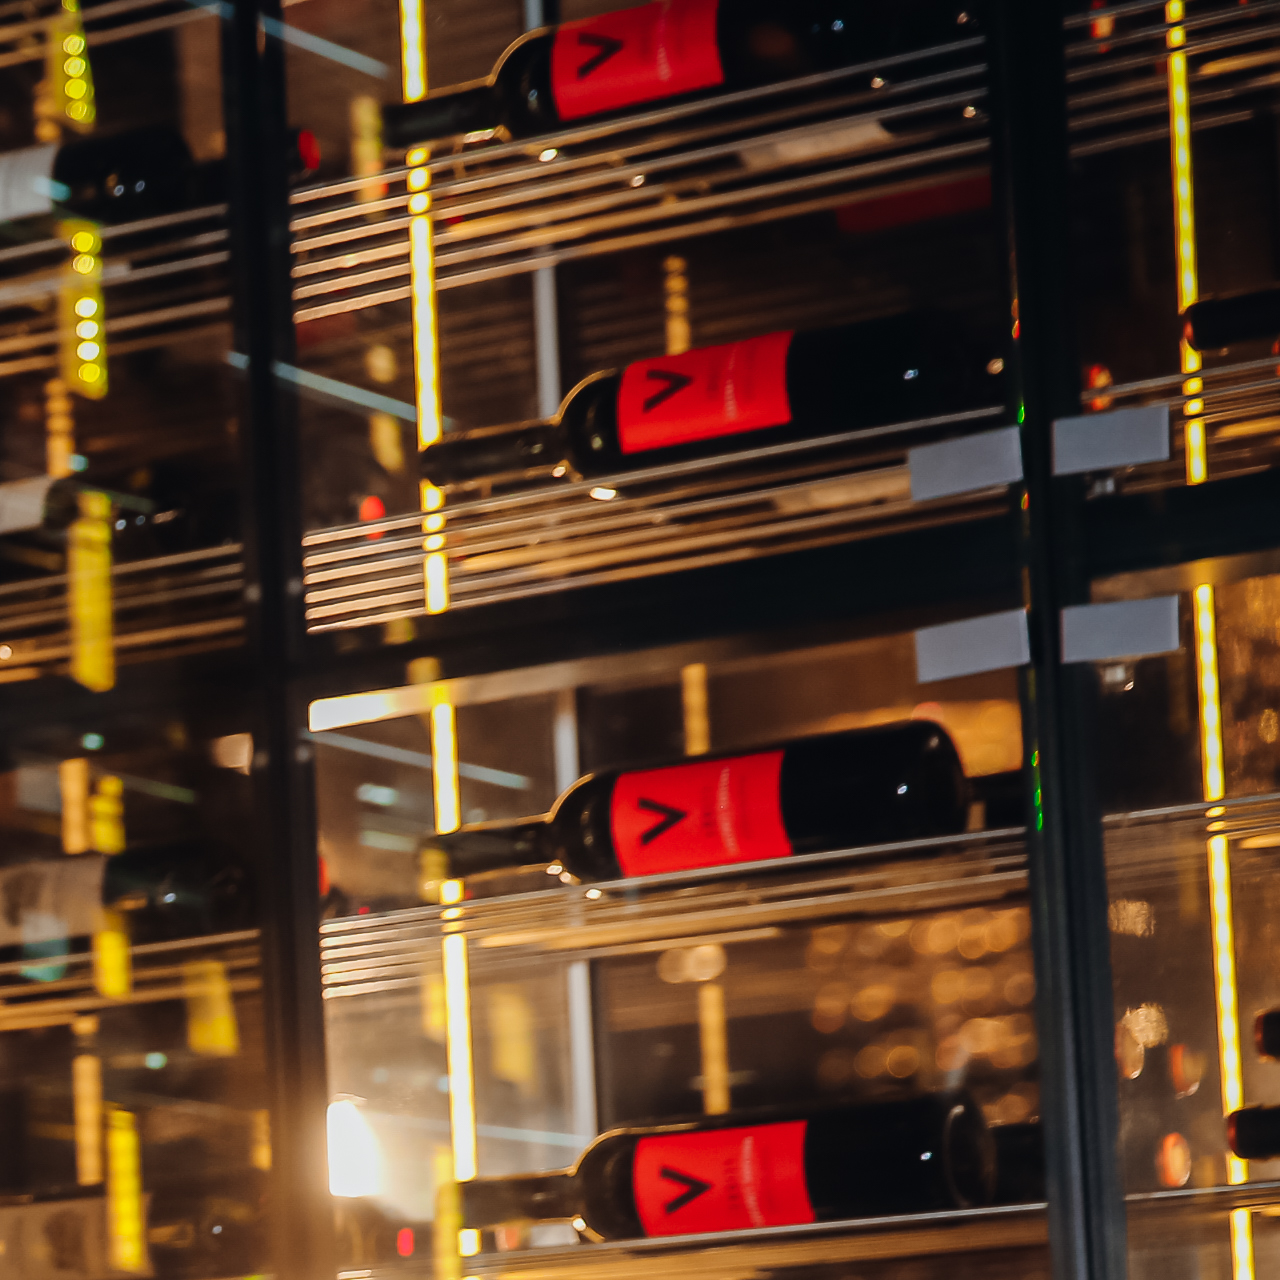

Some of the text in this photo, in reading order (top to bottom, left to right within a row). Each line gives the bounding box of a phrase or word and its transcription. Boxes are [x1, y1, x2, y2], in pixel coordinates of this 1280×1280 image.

[576, 31, 624, 80] V
[642, 369, 693, 414] V
[637, 797, 688, 845] V
[660, 1166, 712, 1215] V
